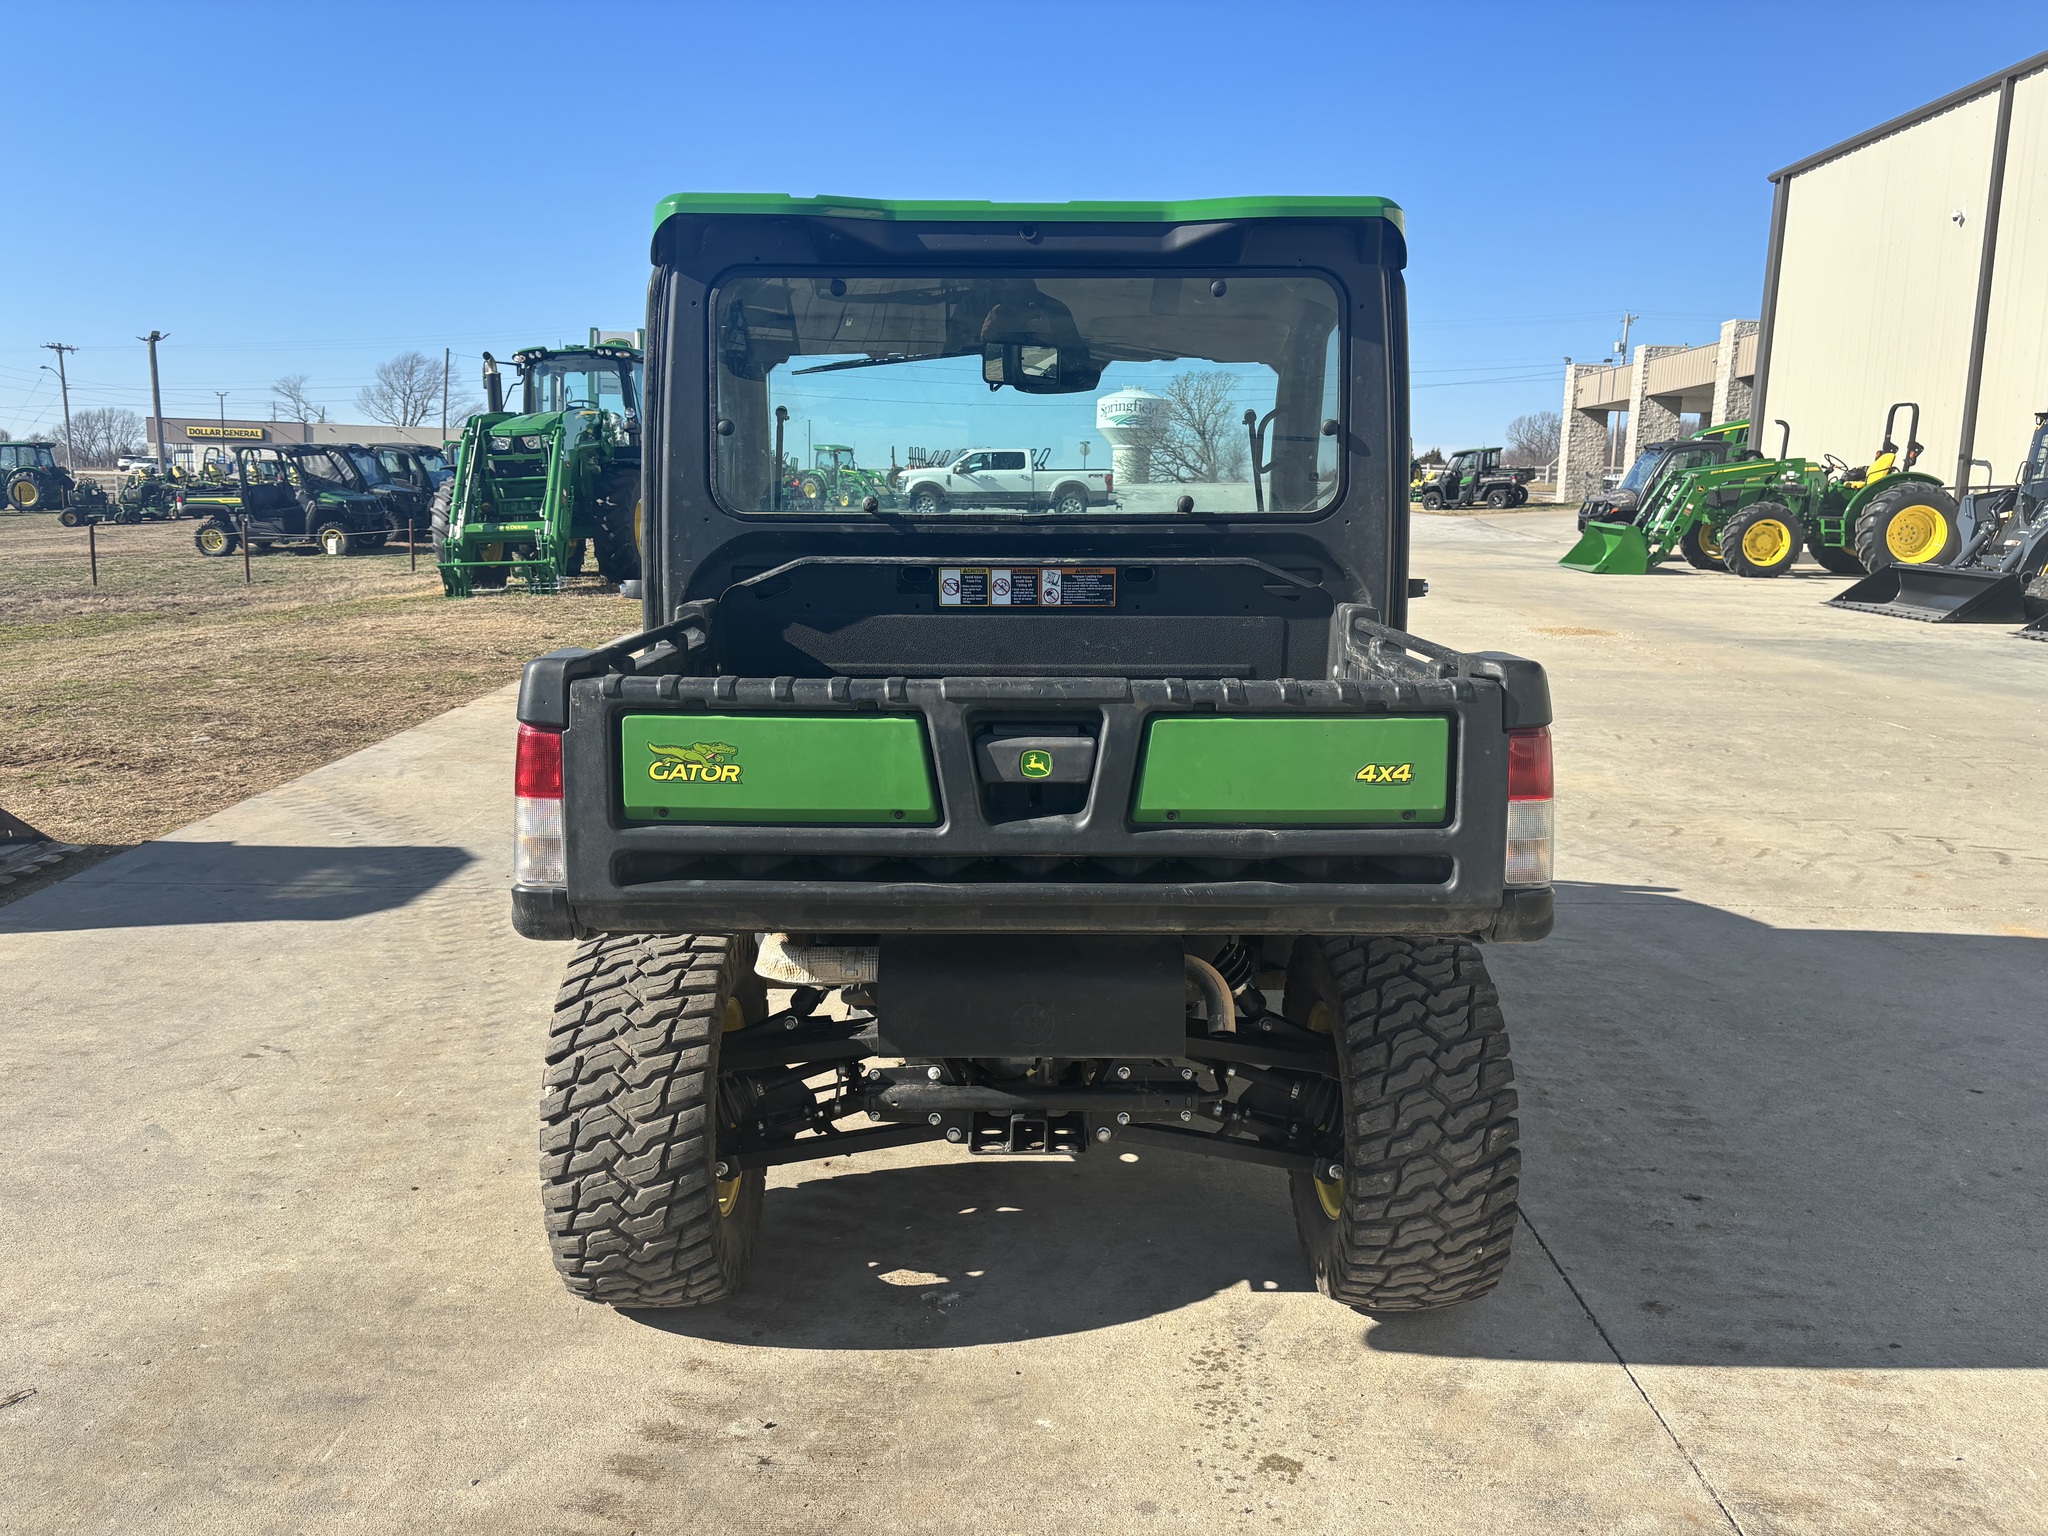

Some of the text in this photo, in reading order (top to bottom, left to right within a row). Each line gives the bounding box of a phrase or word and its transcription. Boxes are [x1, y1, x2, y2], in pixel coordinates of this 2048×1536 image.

[1099, 399, 1158, 418] Springfield
[188, 428, 261, 438] DOLLAR GENERAL
[648, 760, 742, 783] GATOR
[1356, 763, 1413, 783] 4x4
